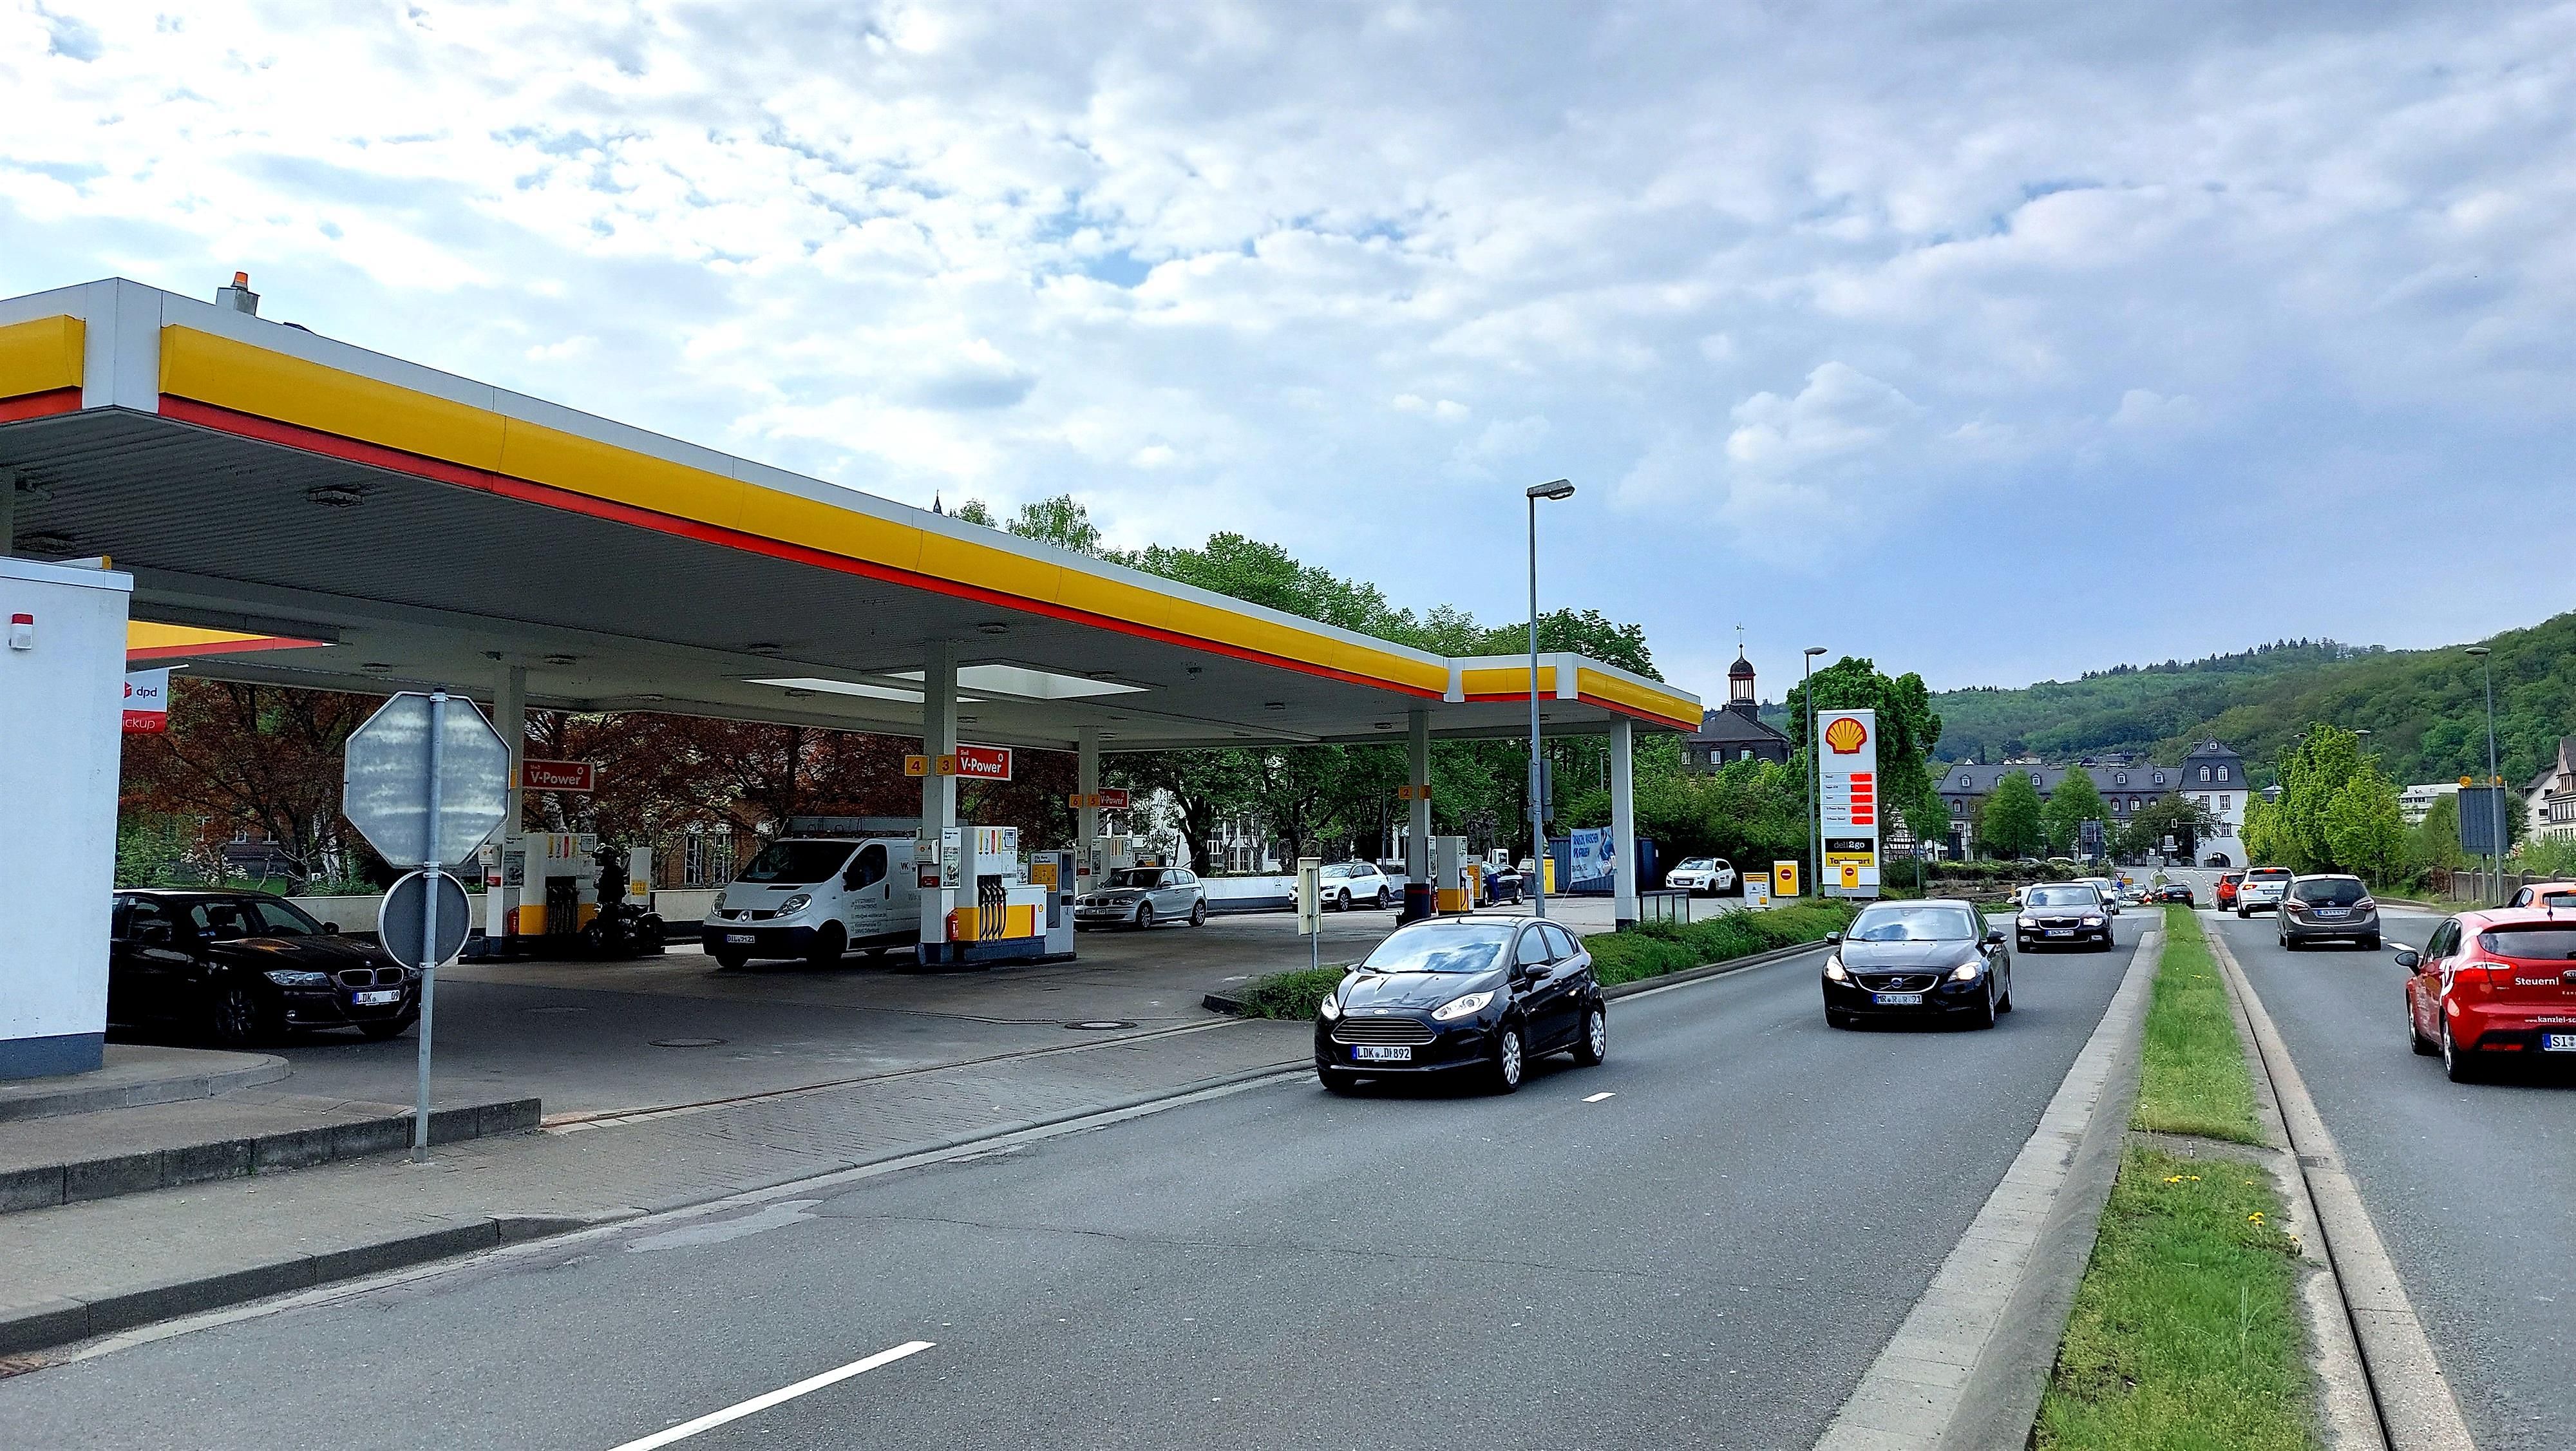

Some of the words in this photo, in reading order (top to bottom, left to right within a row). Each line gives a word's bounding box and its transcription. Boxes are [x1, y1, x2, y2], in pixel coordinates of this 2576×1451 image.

[136, 686, 158, 699] dpd
[122, 716, 156, 731] ickup
[911, 760, 922, 772] 4
[942, 759, 951, 772] 3
[961, 757, 1001, 773] V-Power
[530, 771, 582, 786] V-Power
[1100, 794, 1124, 805] V-Power
[1833, 840, 1865, 850] deli2go
[1830, 857, 1870, 865] Taart
[357, 992, 372, 1003] LDK
[2552, 1036, 2568, 1047] SI
[1357, 1047, 1374, 1058] LDK
